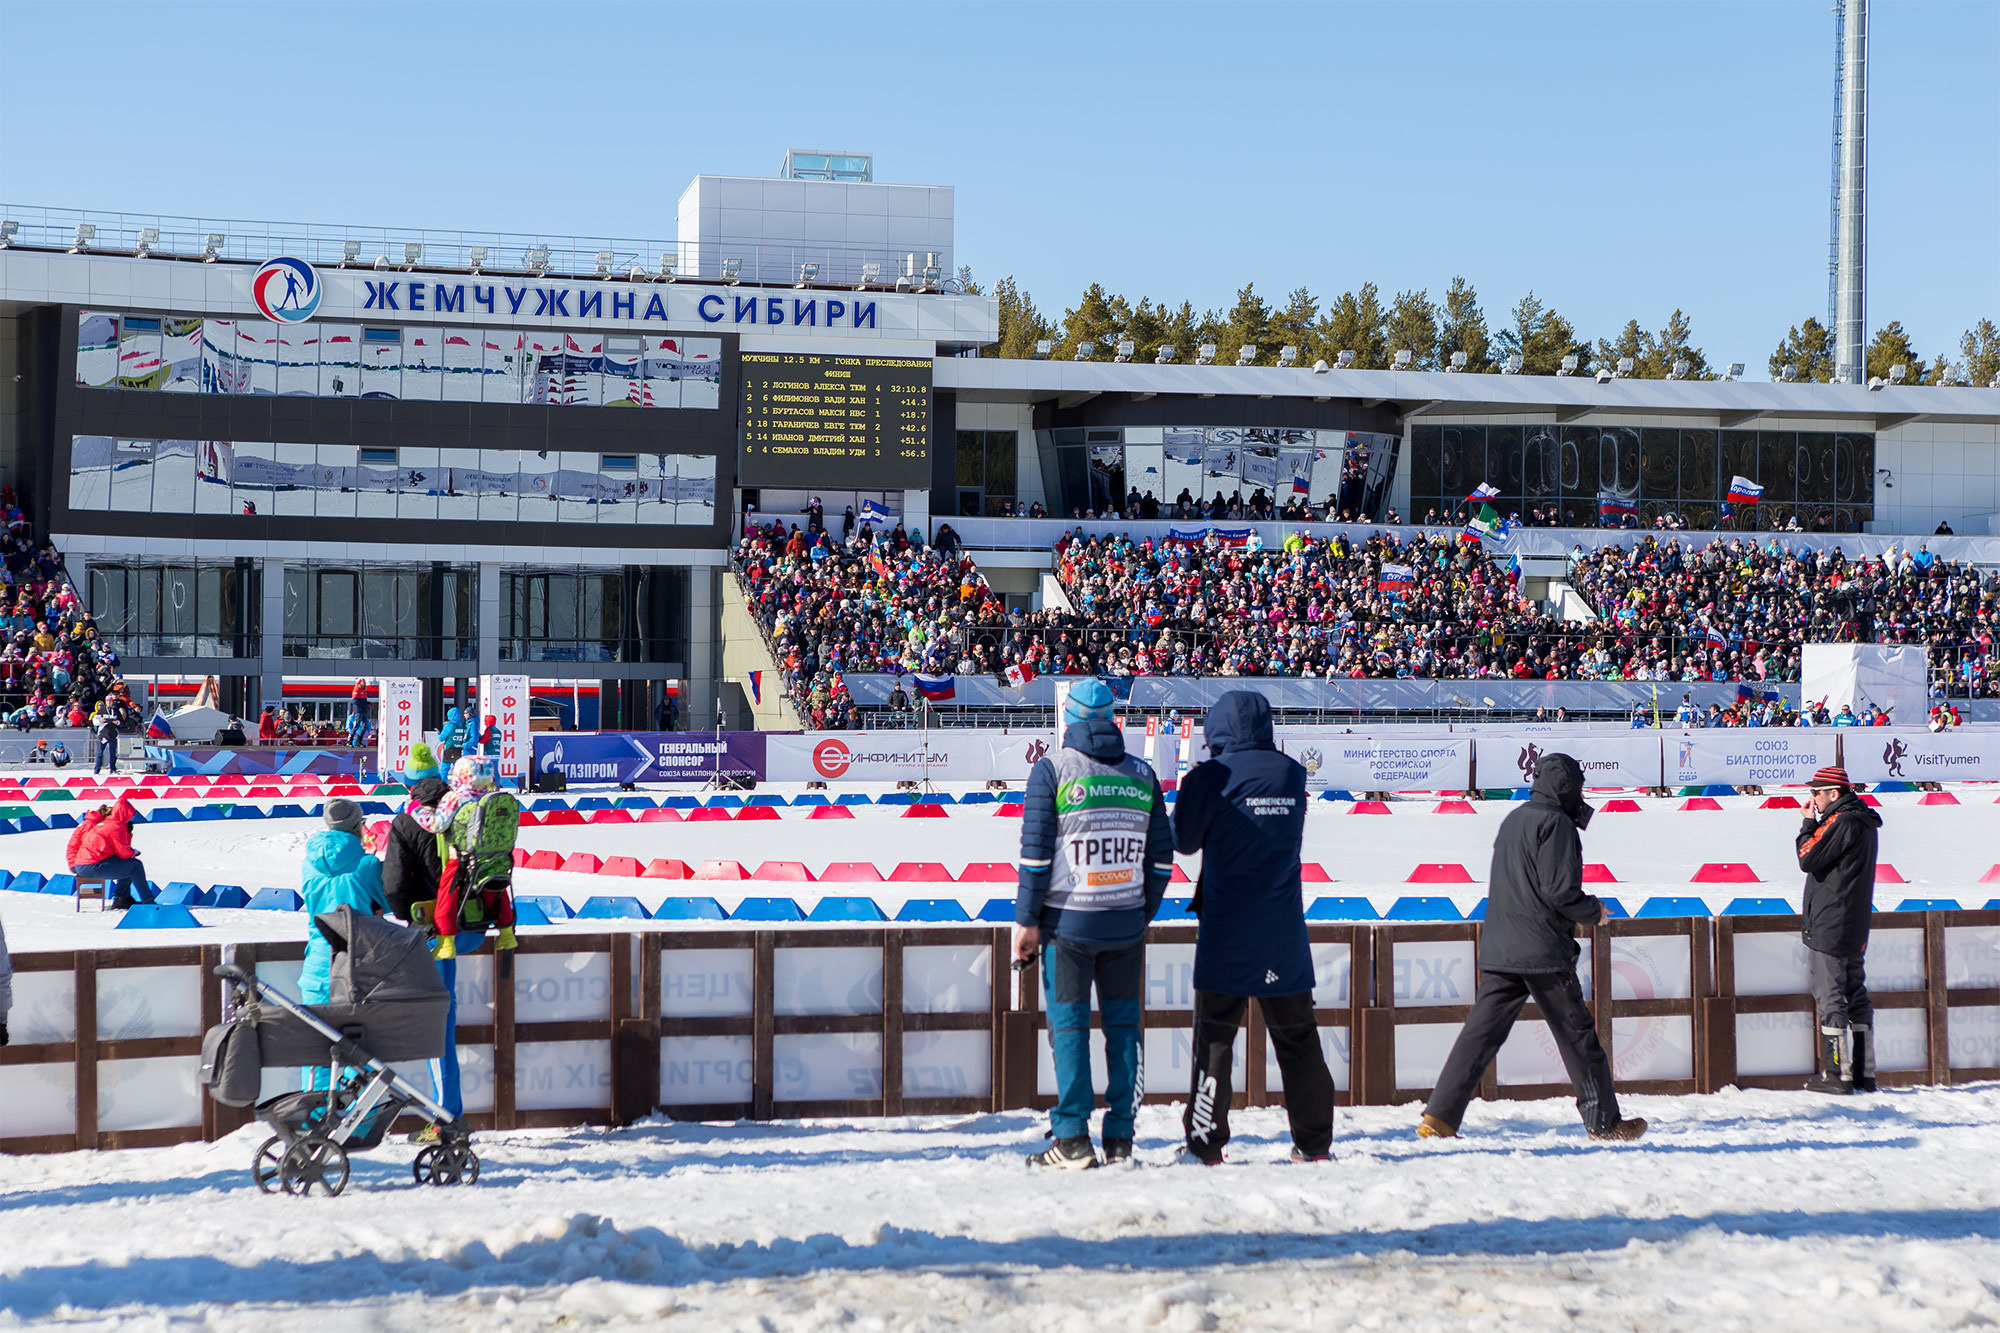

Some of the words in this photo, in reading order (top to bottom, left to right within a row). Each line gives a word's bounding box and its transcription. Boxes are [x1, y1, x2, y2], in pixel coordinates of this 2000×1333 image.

[363, 280, 668, 321] ЖЕМЧУЖИНА
[698, 294, 876, 329] СИБИРИ
[866, 359, 932, 367] ПРЕСЛЕДОВАНИЯ
[891, 385, 926, 393] 32:10.8
[824, 396, 845, 404] ВАДИ
[808, 434, 845, 442] ДМИТРИЙ
[1148, 724, 1153, 735] 2
[1183, 725, 1188, 737] 3
[501, 696, 517, 776] ФИНИШ
[659, 741, 728, 754] ГЕНЕРАЛЬНЫЙ
[1755, 740, 1788, 751] СОЮЗ
[850, 753, 948, 763] ИНФИНИТУМ
[1344, 749, 1418, 759] МИНИСТЕРСТВО
[1420, 748, 1457, 758] СПОРТА
[659, 755, 704, 767] СПОНСОР
[1369, 760, 1432, 770] РОССИЙСКОЙ
[1576, 759, 1619, 770] Tyumen
[1726, 754, 1817, 766] БИАТЛОНИСТОВ
[1914, 754, 1981, 767] VisitTyumen
[563, 763, 618, 778] ГАЗПРОМ
[731, 769, 756, 777] РОССИИ
[1373, 771, 1428, 781] ФЕДЕРАЦИИ
[1749, 769, 1795, 779] РОССИИ
[1245, 797, 1296, 806] ТЮМЕНСКАЯ
[1254, 806, 1289, 815] ОБЛАСТЬ
[1071, 837, 1143, 866] ТРЕНЕР
